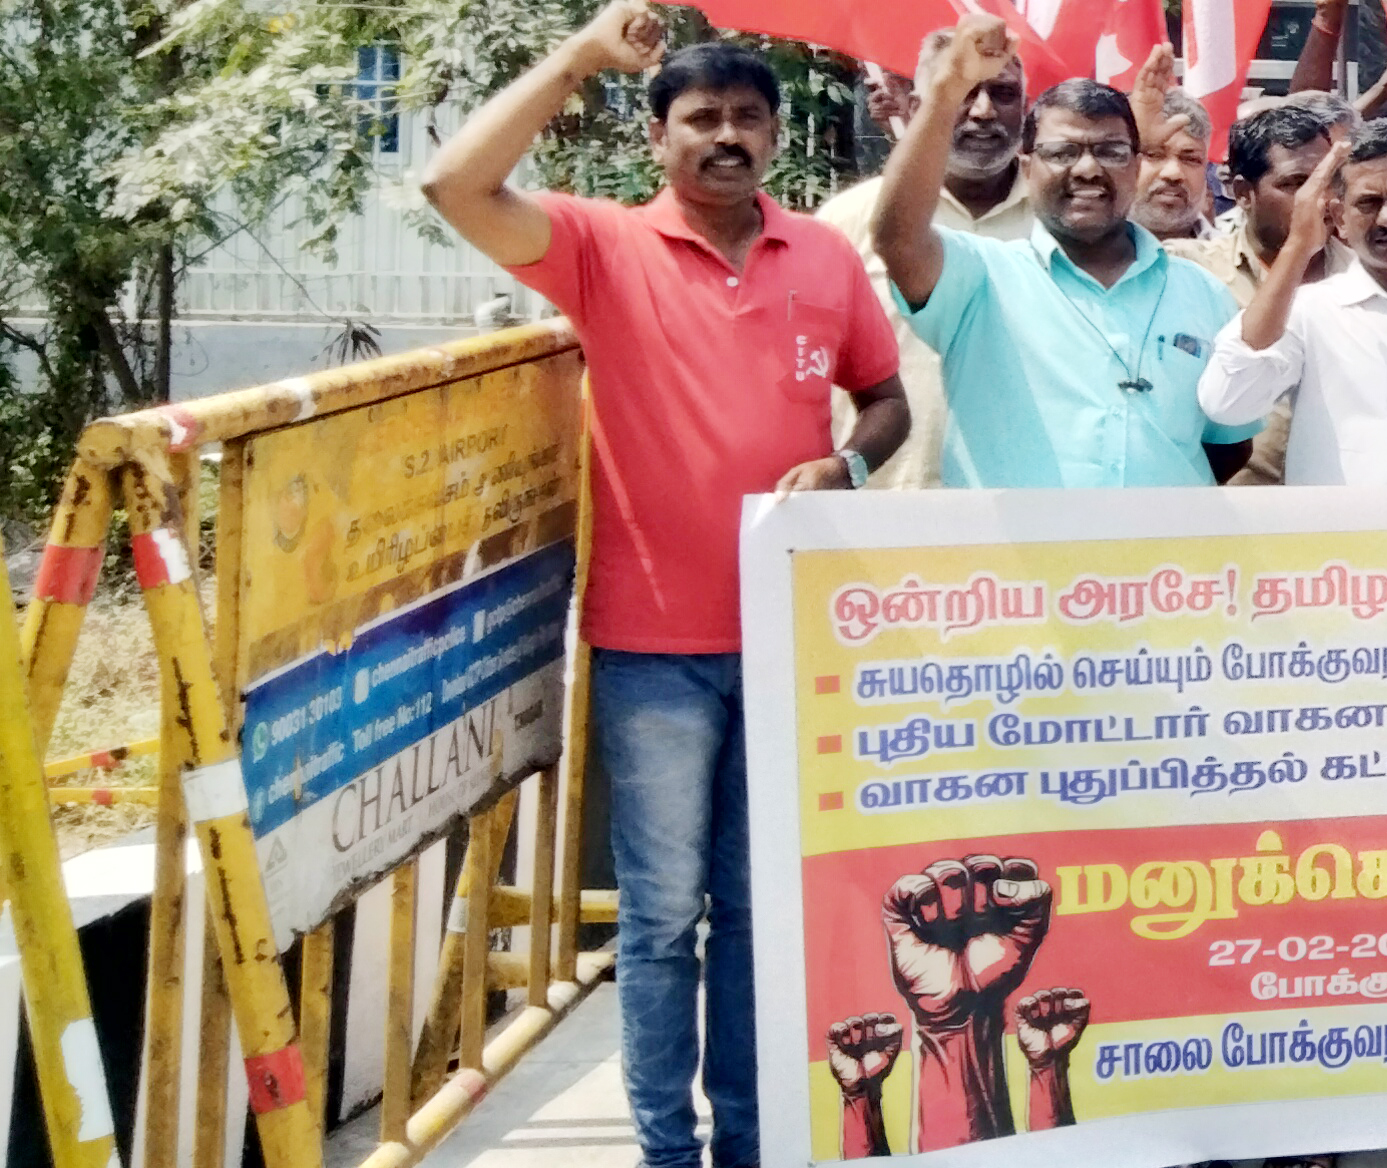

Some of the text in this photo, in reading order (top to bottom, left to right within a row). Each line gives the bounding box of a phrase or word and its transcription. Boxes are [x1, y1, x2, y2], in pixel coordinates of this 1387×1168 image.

[796, 335, 807, 382] CITU
[835, 577, 1043, 640] ஒன்றிய
[1059, 569, 1237, 622] அரசே!
[857, 653, 1064, 704] சுயதொழில்
[1072, 645, 1212, 693] செய்யும்
[858, 717, 974, 765] புதிய
[989, 706, 1210, 746] மோட்டார்
[1223, 704, 1387, 735] வாகன
[332, 699, 497, 853] CHALLANI
[861, 770, 1029, 809] வாகன
[1041, 751, 1308, 805] புதுப்பித்தல்
[1096, 1038, 1213, 1079] சாலை
